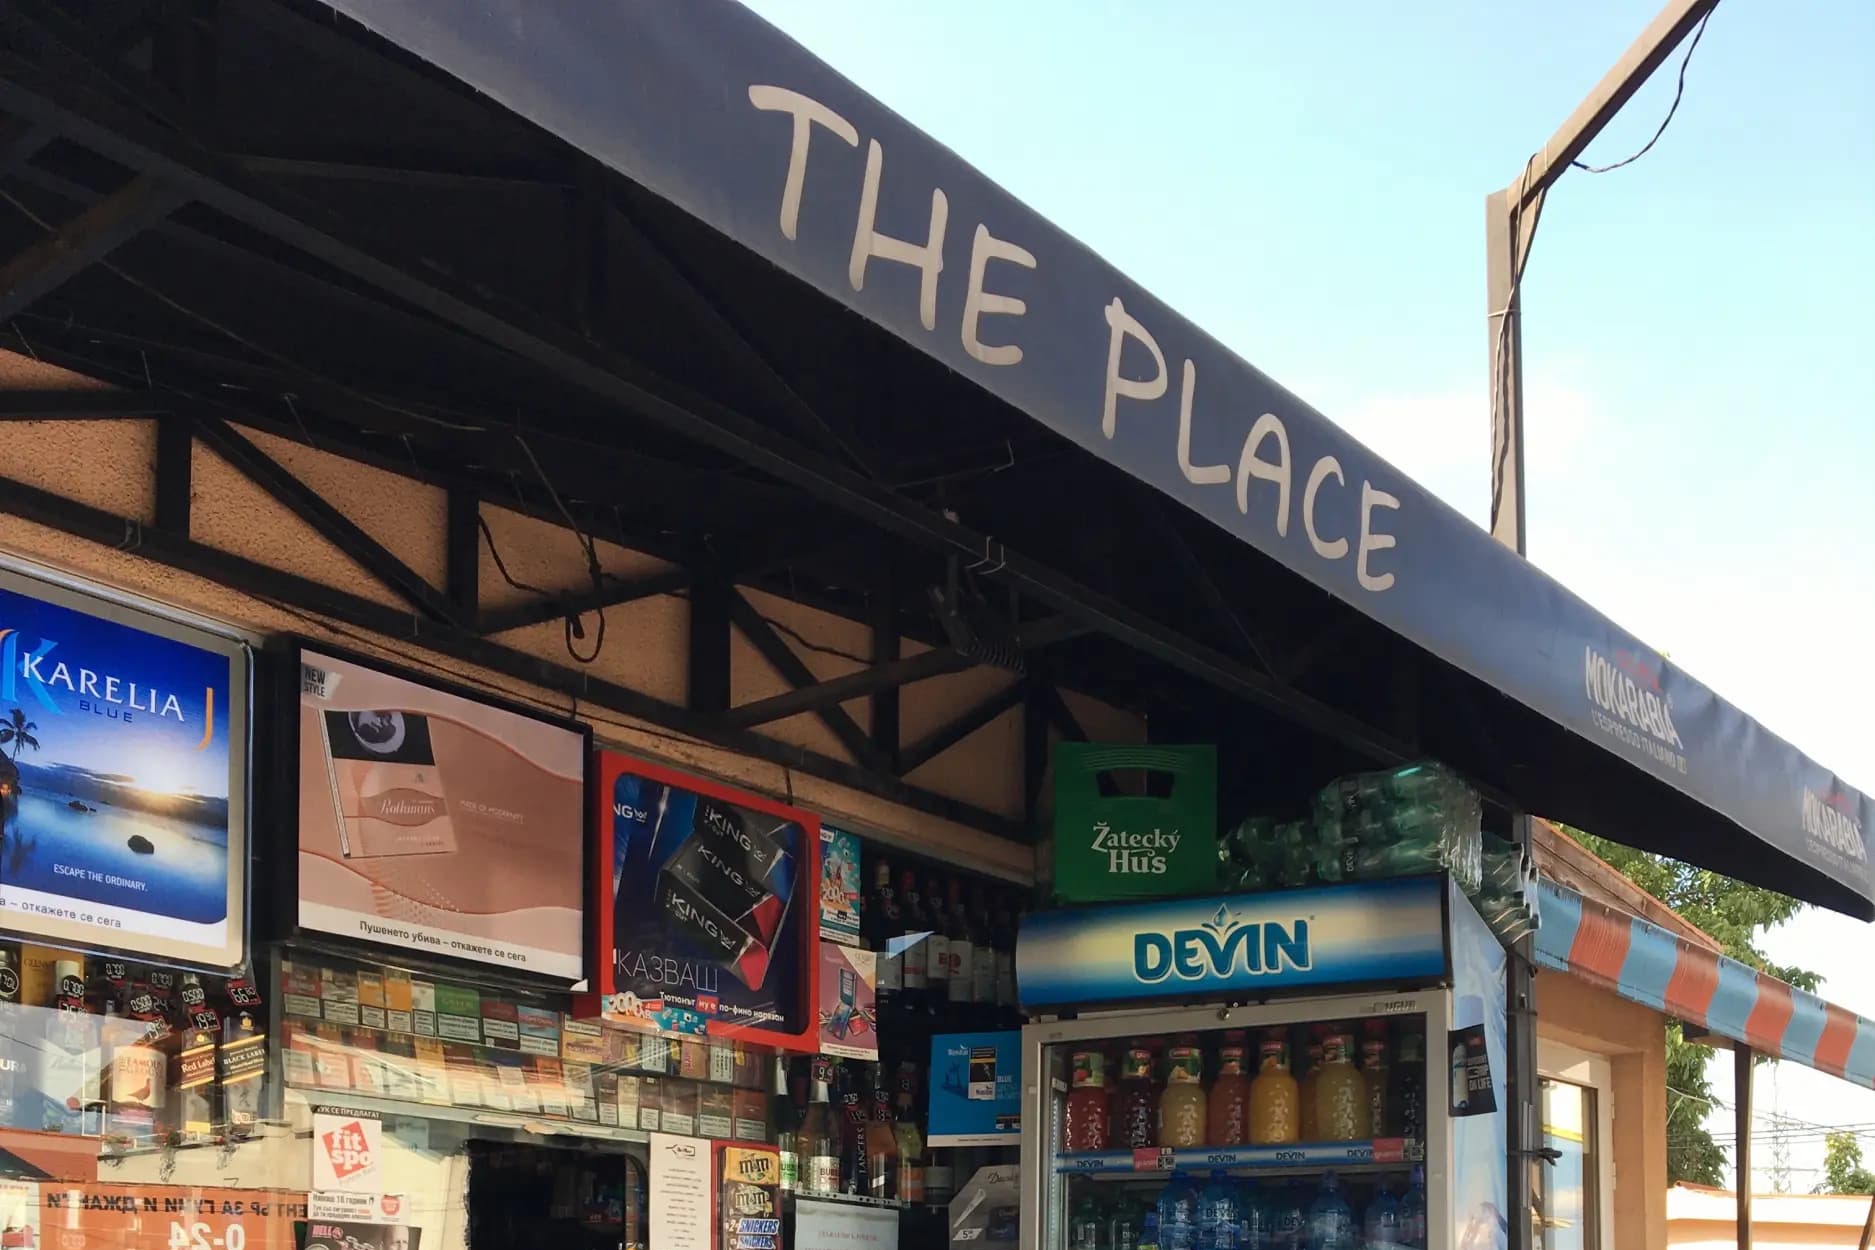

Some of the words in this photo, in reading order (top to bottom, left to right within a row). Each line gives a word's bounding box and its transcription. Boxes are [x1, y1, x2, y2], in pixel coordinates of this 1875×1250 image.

[748, 84, 1037, 366] THE
[1103, 297, 1401, 592] PLACE
[23, 651, 185, 722] KARELIA
[304, 667, 326, 684] NEW
[79, 699, 134, 723] BLUE
[1585, 646, 1684, 750] MOKARABIA
[379, 798, 436, 816] Rothmans
[709, 811, 752, 851] KING
[1091, 821, 1180, 853] Žatecký
[698, 845, 744, 886] KING
[1108, 848, 1168, 875] Hus
[53, 863, 86, 880] ESCAPE
[87, 871, 104, 883] THE
[105, 873, 148, 892] ORDINARY.
[22, 901, 76, 919] откажете
[80, 912, 94, 923] се
[97, 915, 122, 928] сега
[672, 893, 718, 938] KING
[359, 920, 410, 940] Пушенето
[411, 928, 441, 947] убива
[451, 940, 492, 957] откажете
[494, 950, 505, 959] се
[507, 951, 527, 964] сега
[1133, 917, 1314, 984] DEVIN
[618, 948, 718, 993] КАЗВАШ
[181, 1062, 196, 1074] Red
[341, 1108, 380, 1119] ПРЕДЛАГАТ
[332, 1129, 362, 1151] fit
[1076, 1160, 1104, 1169] DEVIN
[1208, 1155, 1237, 1164] DEVIN
[1276, 1152, 1306, 1161] DEVIN
[1346, 1149, 1373, 1158] DEVI
[740, 1219, 778, 1234] SNICKERS
